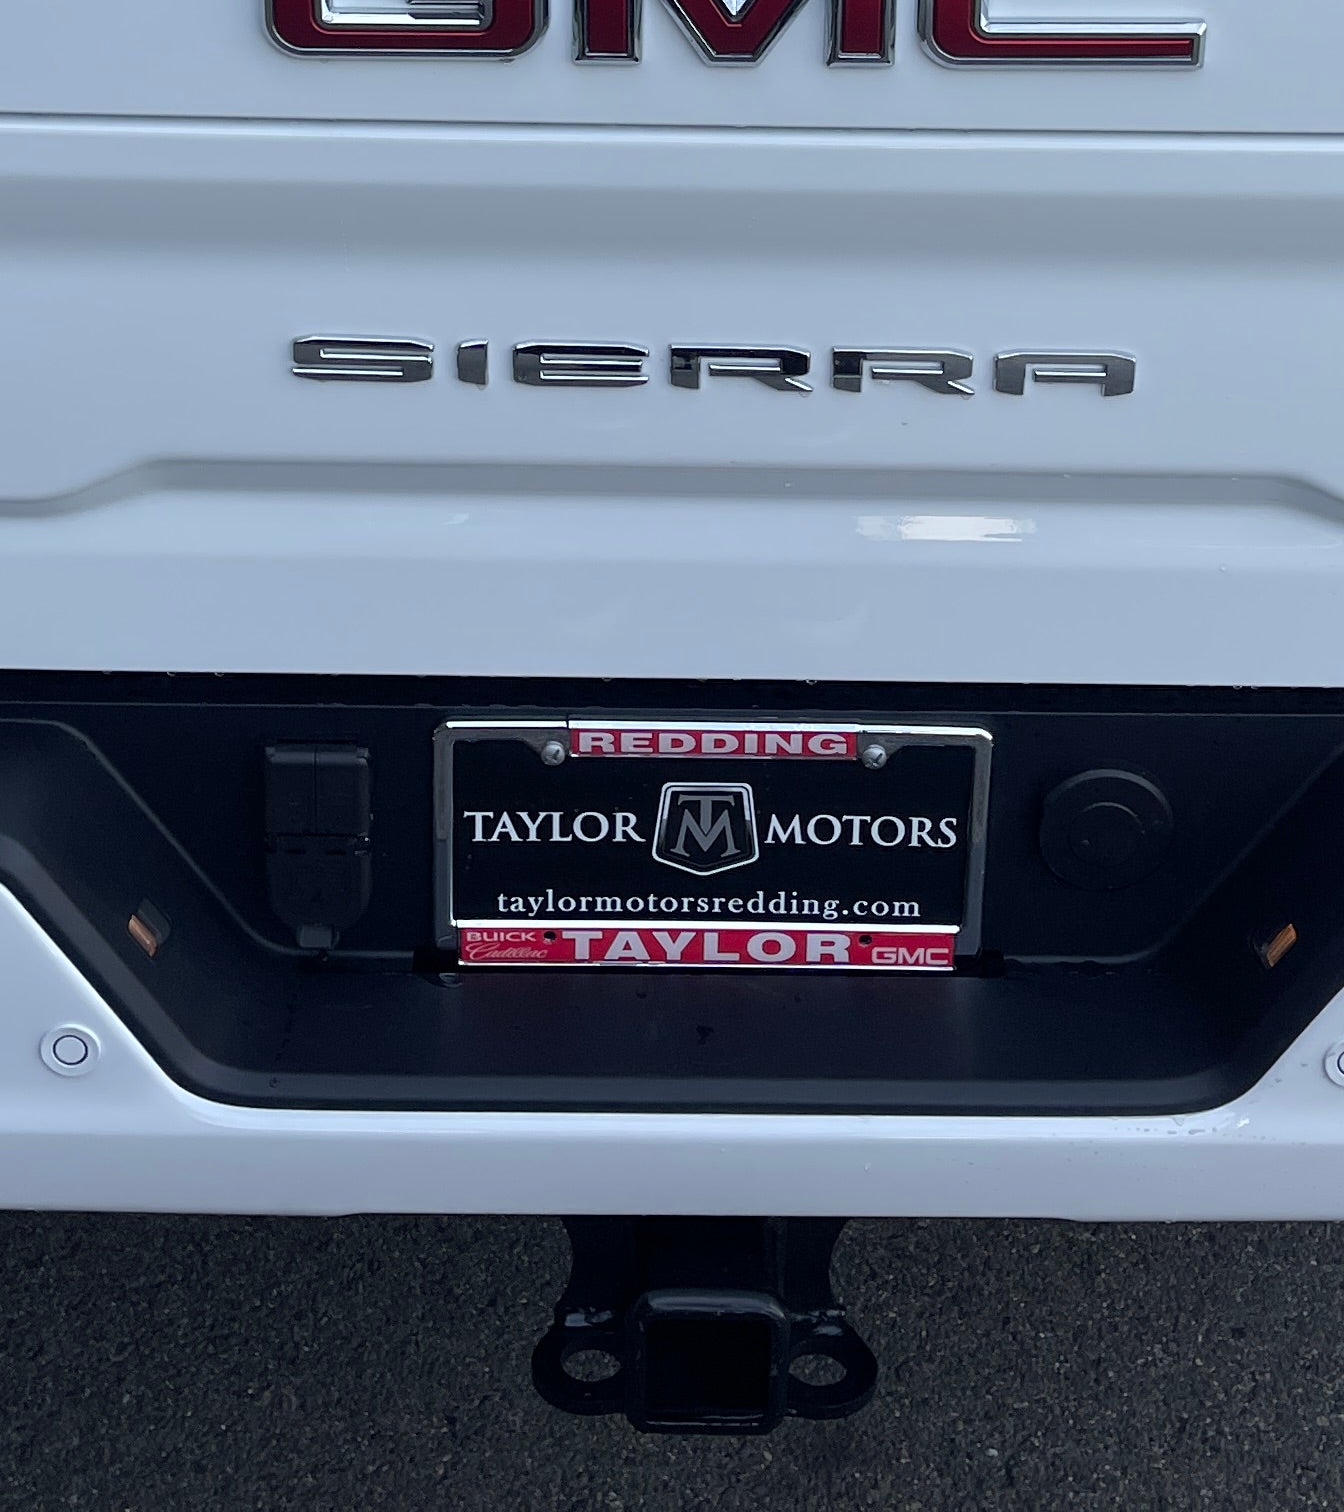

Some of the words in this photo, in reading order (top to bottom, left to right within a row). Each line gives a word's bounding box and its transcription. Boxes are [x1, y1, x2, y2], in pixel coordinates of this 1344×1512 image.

[291, 334, 1138, 398] SIERRA
[578, 732, 848, 755] REDDING
[463, 811, 646, 843] TAYLOR
[763, 813, 958, 849] MOTORS
[497, 889, 921, 919] taylormotorsredding.com
[466, 931, 536, 942] BUICK
[562, 930, 851, 964] TAYLOR
[464, 941, 549, 961] Cadillac
[870, 946, 950, 967] GMC
